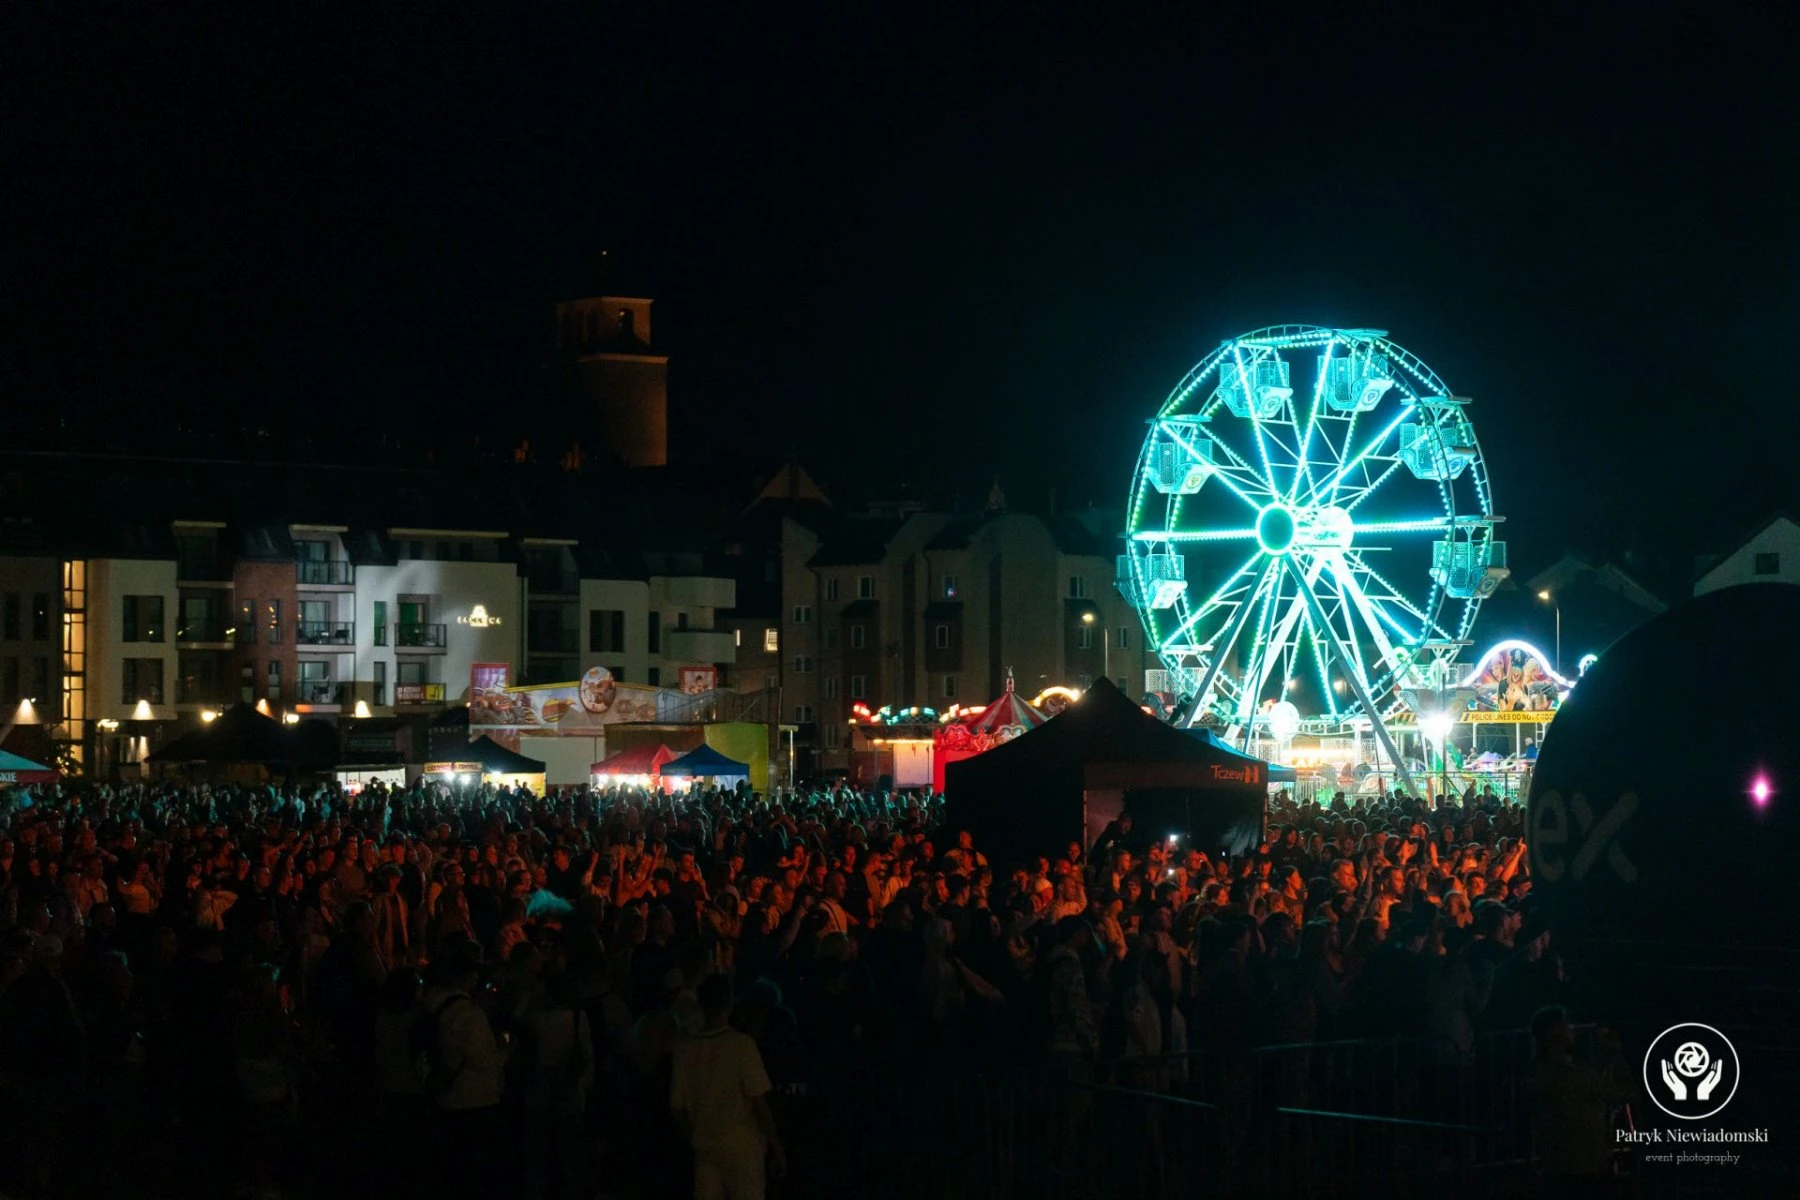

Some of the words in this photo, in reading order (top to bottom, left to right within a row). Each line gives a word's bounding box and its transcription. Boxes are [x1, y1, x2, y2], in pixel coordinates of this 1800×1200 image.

[1471, 713, 1491, 721] POLICE
[1494, 713, 1511, 721] LNES
[1512, 713, 1522, 721] DO
[1522, 713, 1535, 721] NO
[0, 772, 17, 782] KIE
[1210, 765, 1245, 780] Tczew
